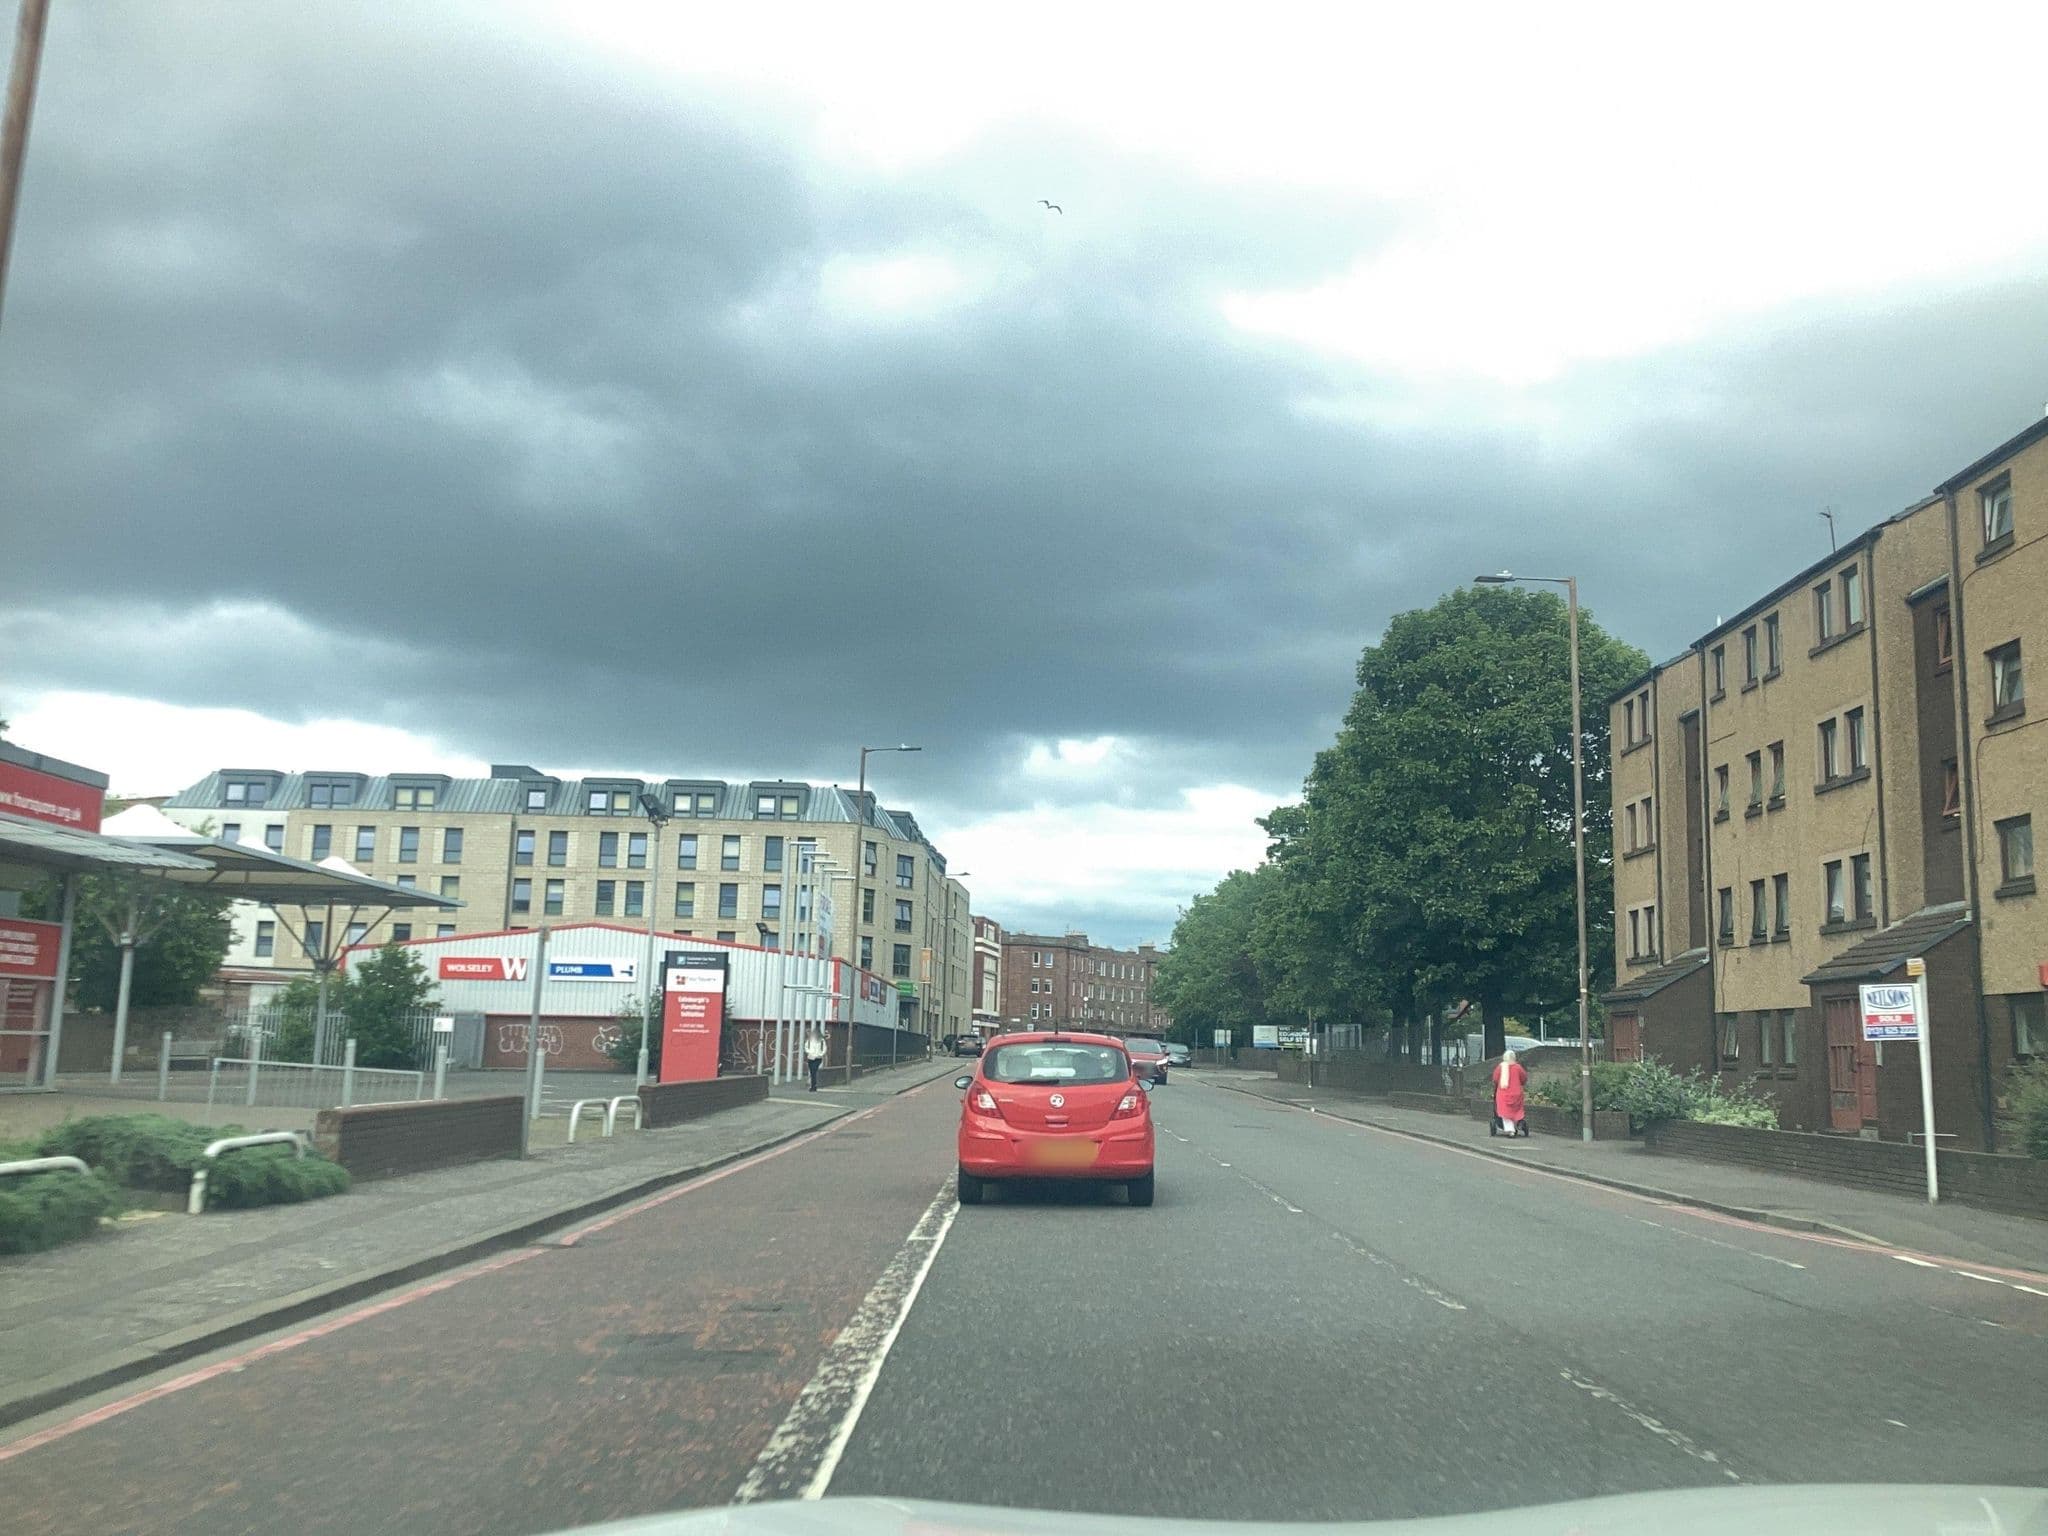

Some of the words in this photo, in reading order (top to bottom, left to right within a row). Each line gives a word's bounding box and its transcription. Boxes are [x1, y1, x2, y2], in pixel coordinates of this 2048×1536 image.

[446, 964, 492, 973] WOLSELEY
[554, 965, 582, 974] PLUMB
[1866, 989, 1910, 1006] NEILSONS
